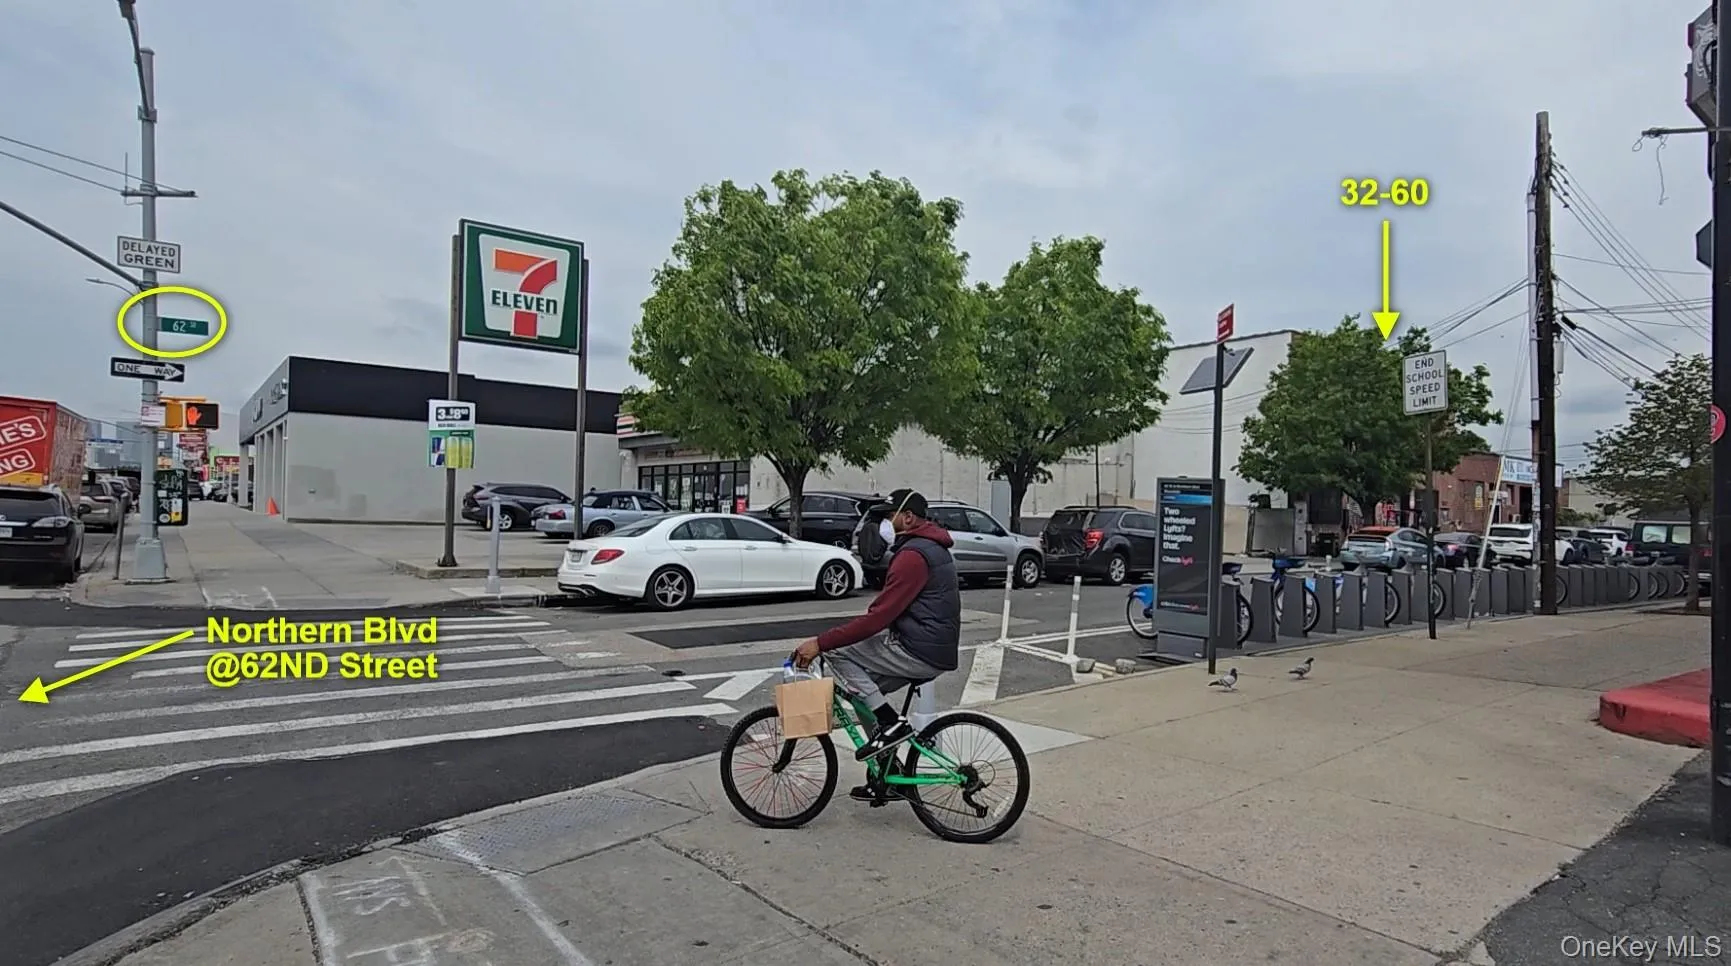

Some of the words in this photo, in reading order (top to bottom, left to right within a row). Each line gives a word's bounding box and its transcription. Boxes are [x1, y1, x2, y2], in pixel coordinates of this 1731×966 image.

[122, 241, 176, 257] DELAYED
[123, 253, 175, 269] GREEN
[493, 248, 558, 338] 7
[172, 320, 187, 333] 62
[117, 363, 141, 374] ONE
[154, 367, 176, 377] WAY
[1414, 357, 1434, 370] END
[1406, 368, 1444, 384] SCHOOL
[1409, 382, 1440, 396] SPEED
[1412, 395, 1437, 408] LIMIT
[1164, 507, 1180, 515] Two
